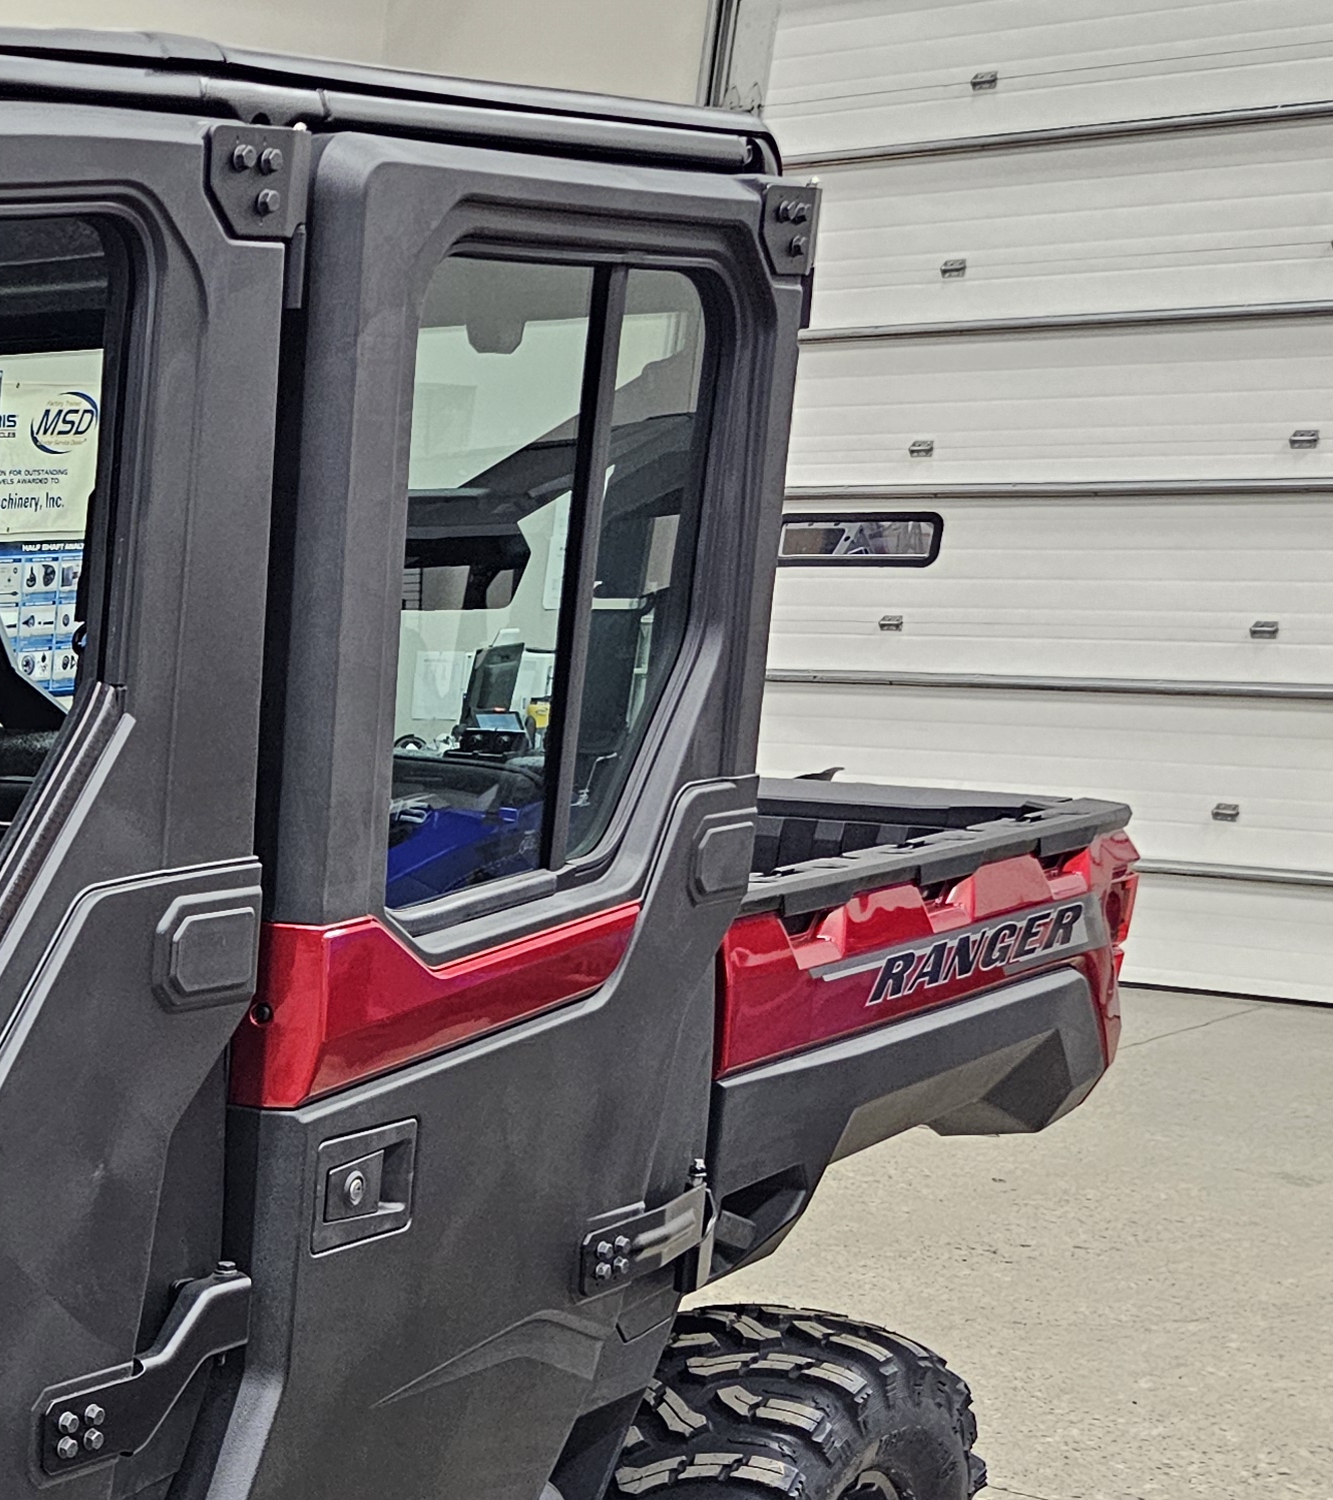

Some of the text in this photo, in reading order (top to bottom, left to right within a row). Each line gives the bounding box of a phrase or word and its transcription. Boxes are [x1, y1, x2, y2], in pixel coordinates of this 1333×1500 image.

[36, 409, 94, 435] MSD
[45, 492, 65, 508] Inc.
[865, 902, 1085, 1007] RANGER
